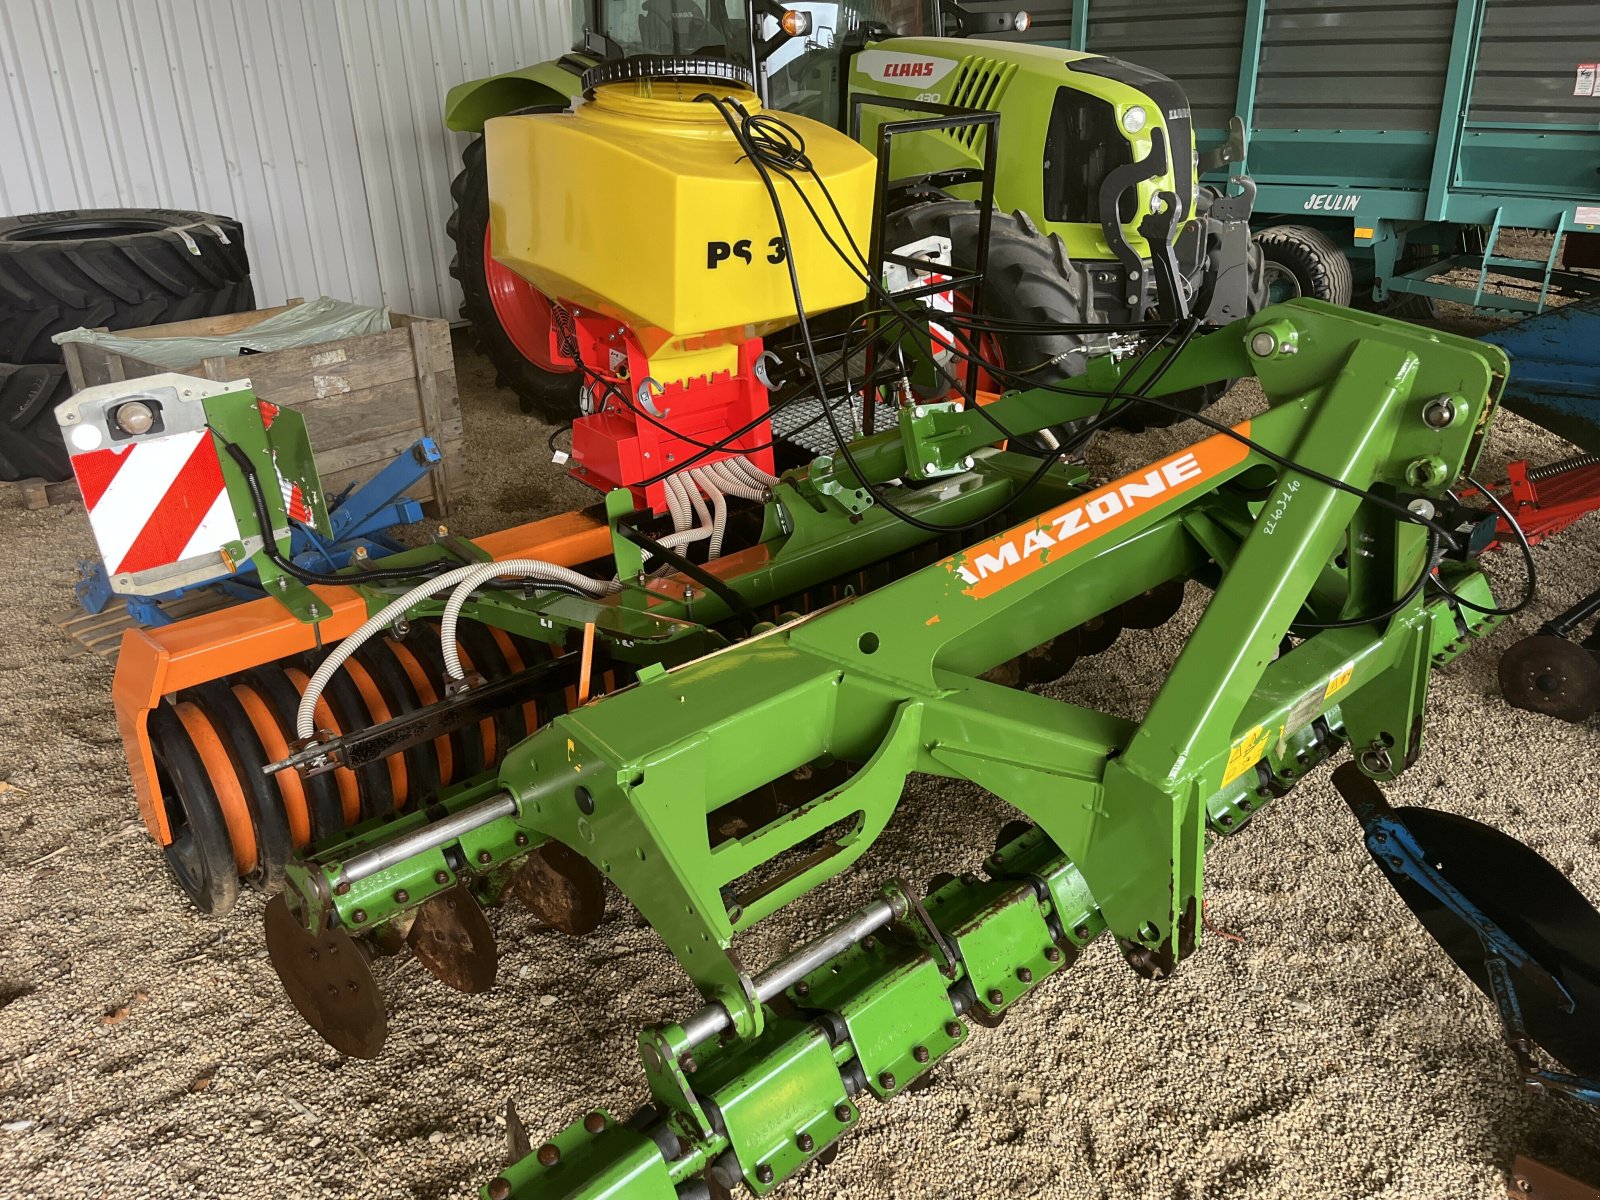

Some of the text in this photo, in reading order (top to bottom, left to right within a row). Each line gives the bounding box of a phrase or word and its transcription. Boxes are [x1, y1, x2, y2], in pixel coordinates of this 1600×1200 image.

[883, 62, 935, 78] CLAAS
[914, 92, 941, 104] 430
[1303, 193, 1361, 212] JEULIN
